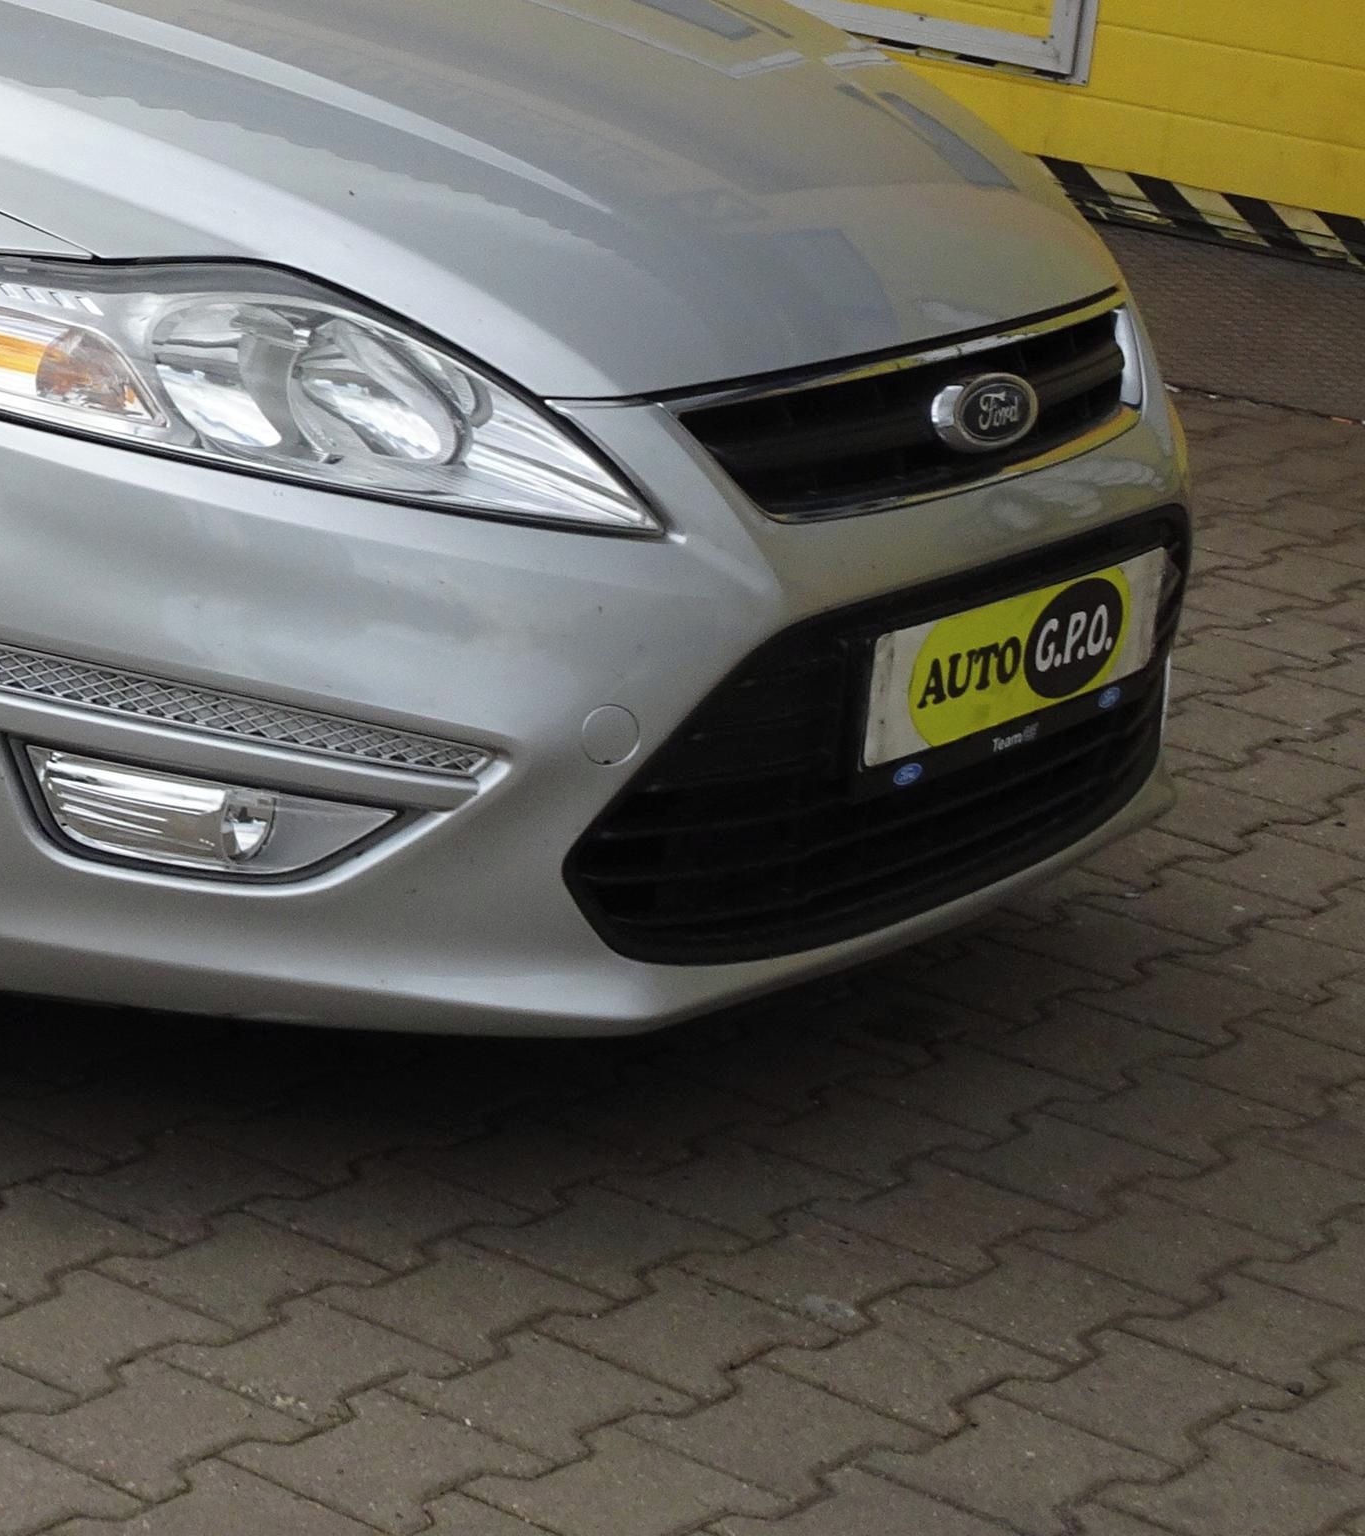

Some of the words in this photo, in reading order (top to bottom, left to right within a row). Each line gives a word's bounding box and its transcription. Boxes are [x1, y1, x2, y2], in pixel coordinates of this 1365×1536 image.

[978, 391, 1019, 431] Ford
[917, 636, 1022, 709] AUTO
[1035, 603, 1113, 673] G.P.O.
